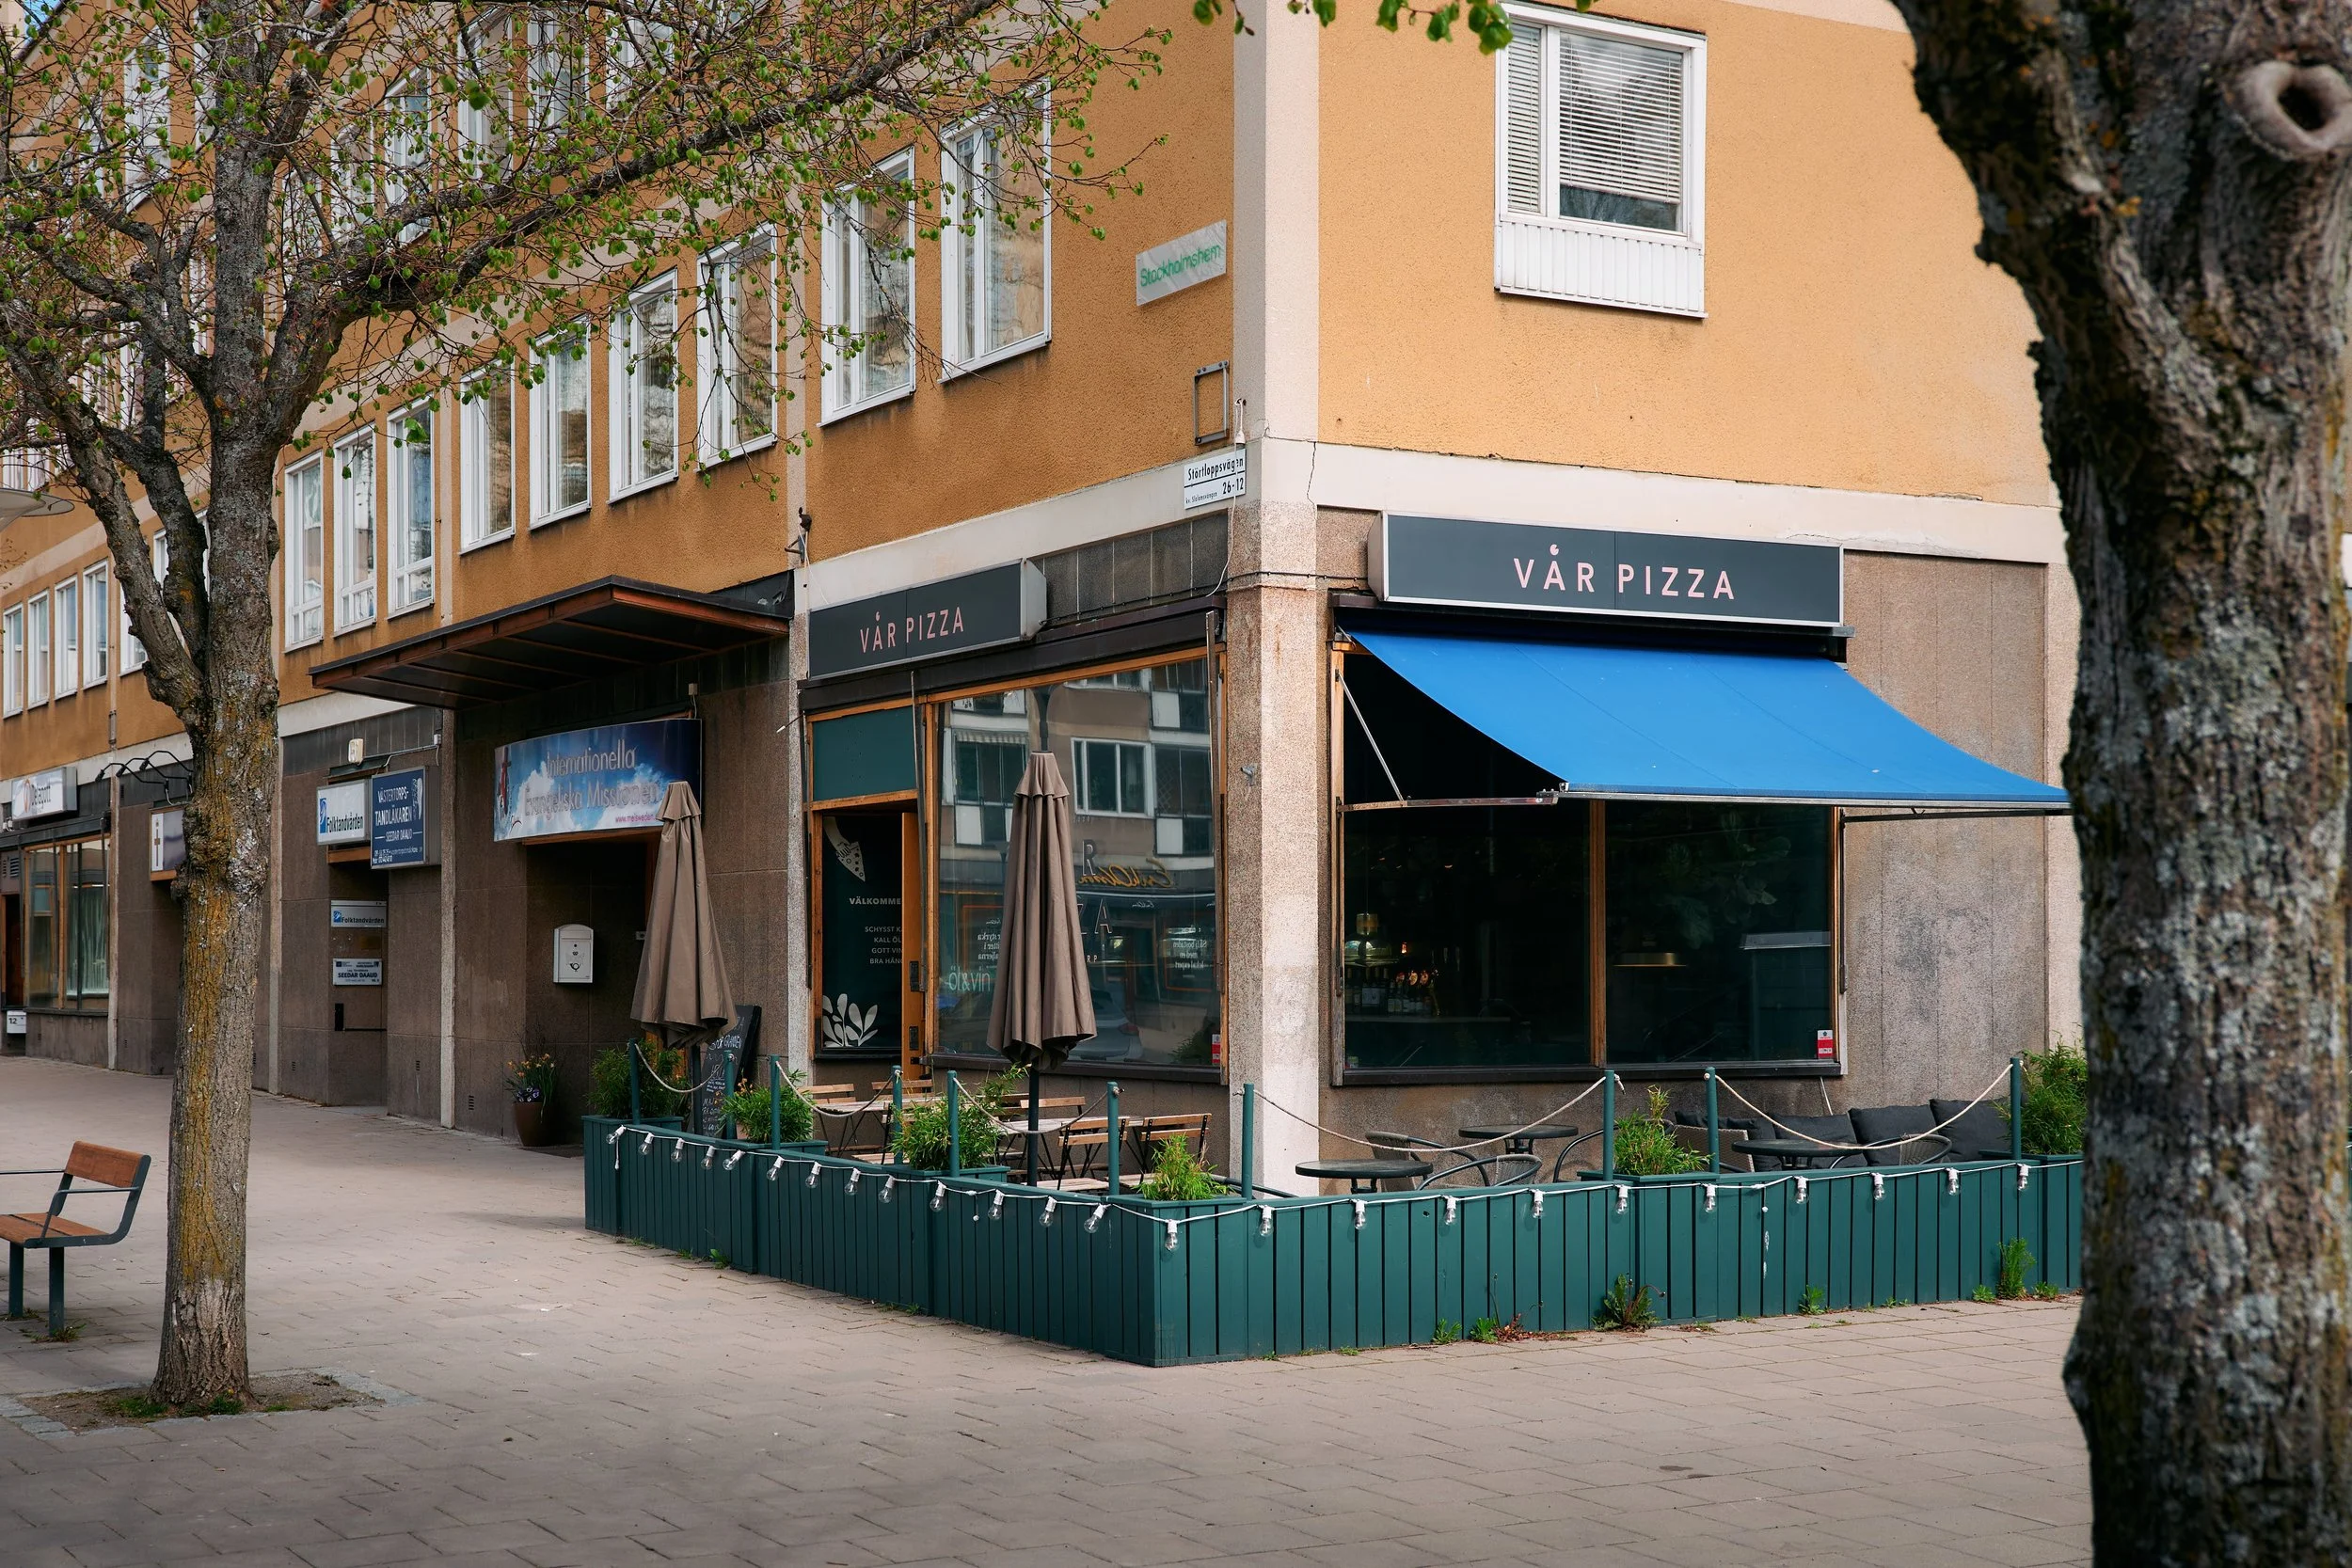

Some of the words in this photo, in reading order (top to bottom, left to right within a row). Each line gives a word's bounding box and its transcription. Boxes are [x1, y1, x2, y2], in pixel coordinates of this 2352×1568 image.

[1140, 245, 1221, 287] Stockholmshem
[1222, 477, 1244, 495] 26-12
[1513, 544, 1596, 593] VÅR
[1617, 563, 1735, 600] PIZZA
[860, 610, 897, 654] VÅR
[906, 606, 964, 643] PIZZA
[547, 738, 637, 779] Internationella
[374, 804, 413, 827] TANDLÄKAREN
[524, 781, 583, 822] Evangeliska
[586, 780, 660, 810] Missionen
[326, 812, 364, 833] Folktandvården
[849, 895, 902, 905] VÄLKOMME
